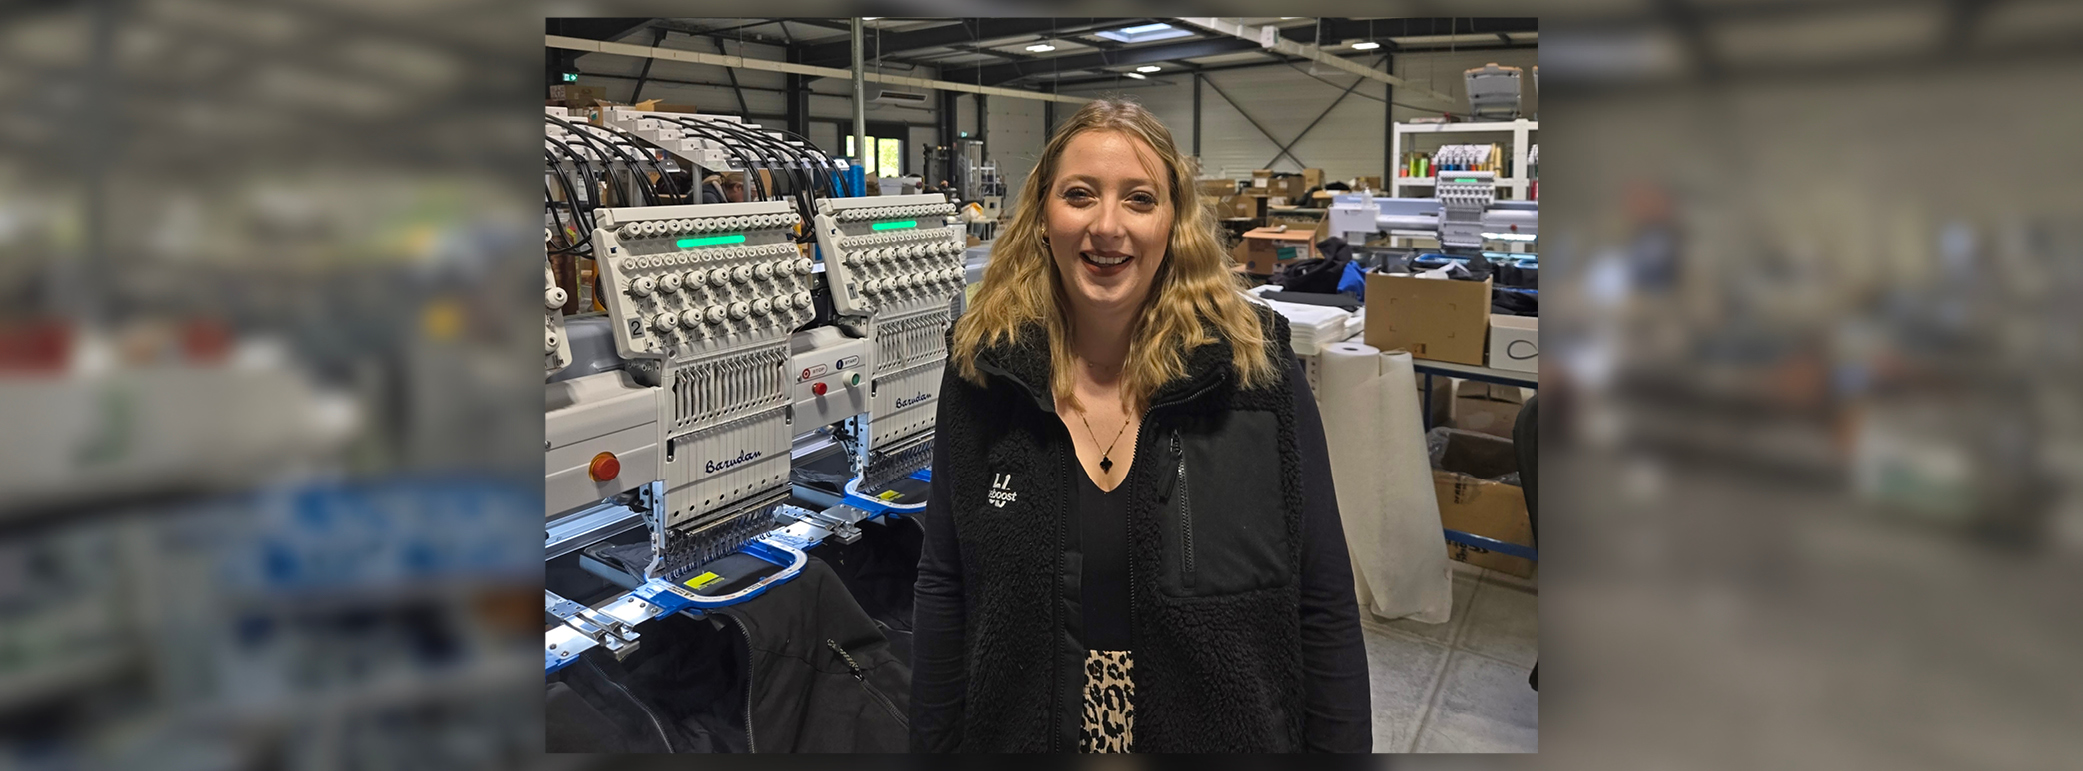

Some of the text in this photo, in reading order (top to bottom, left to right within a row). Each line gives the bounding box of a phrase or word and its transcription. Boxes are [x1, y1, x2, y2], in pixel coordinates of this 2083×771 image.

[850, 285, 856, 297] 1
[631, 320, 642, 336] 2
[812, 366, 825, 374] STOP
[896, 391, 932, 409] Barudan
[705, 449, 762, 474] Barudan
